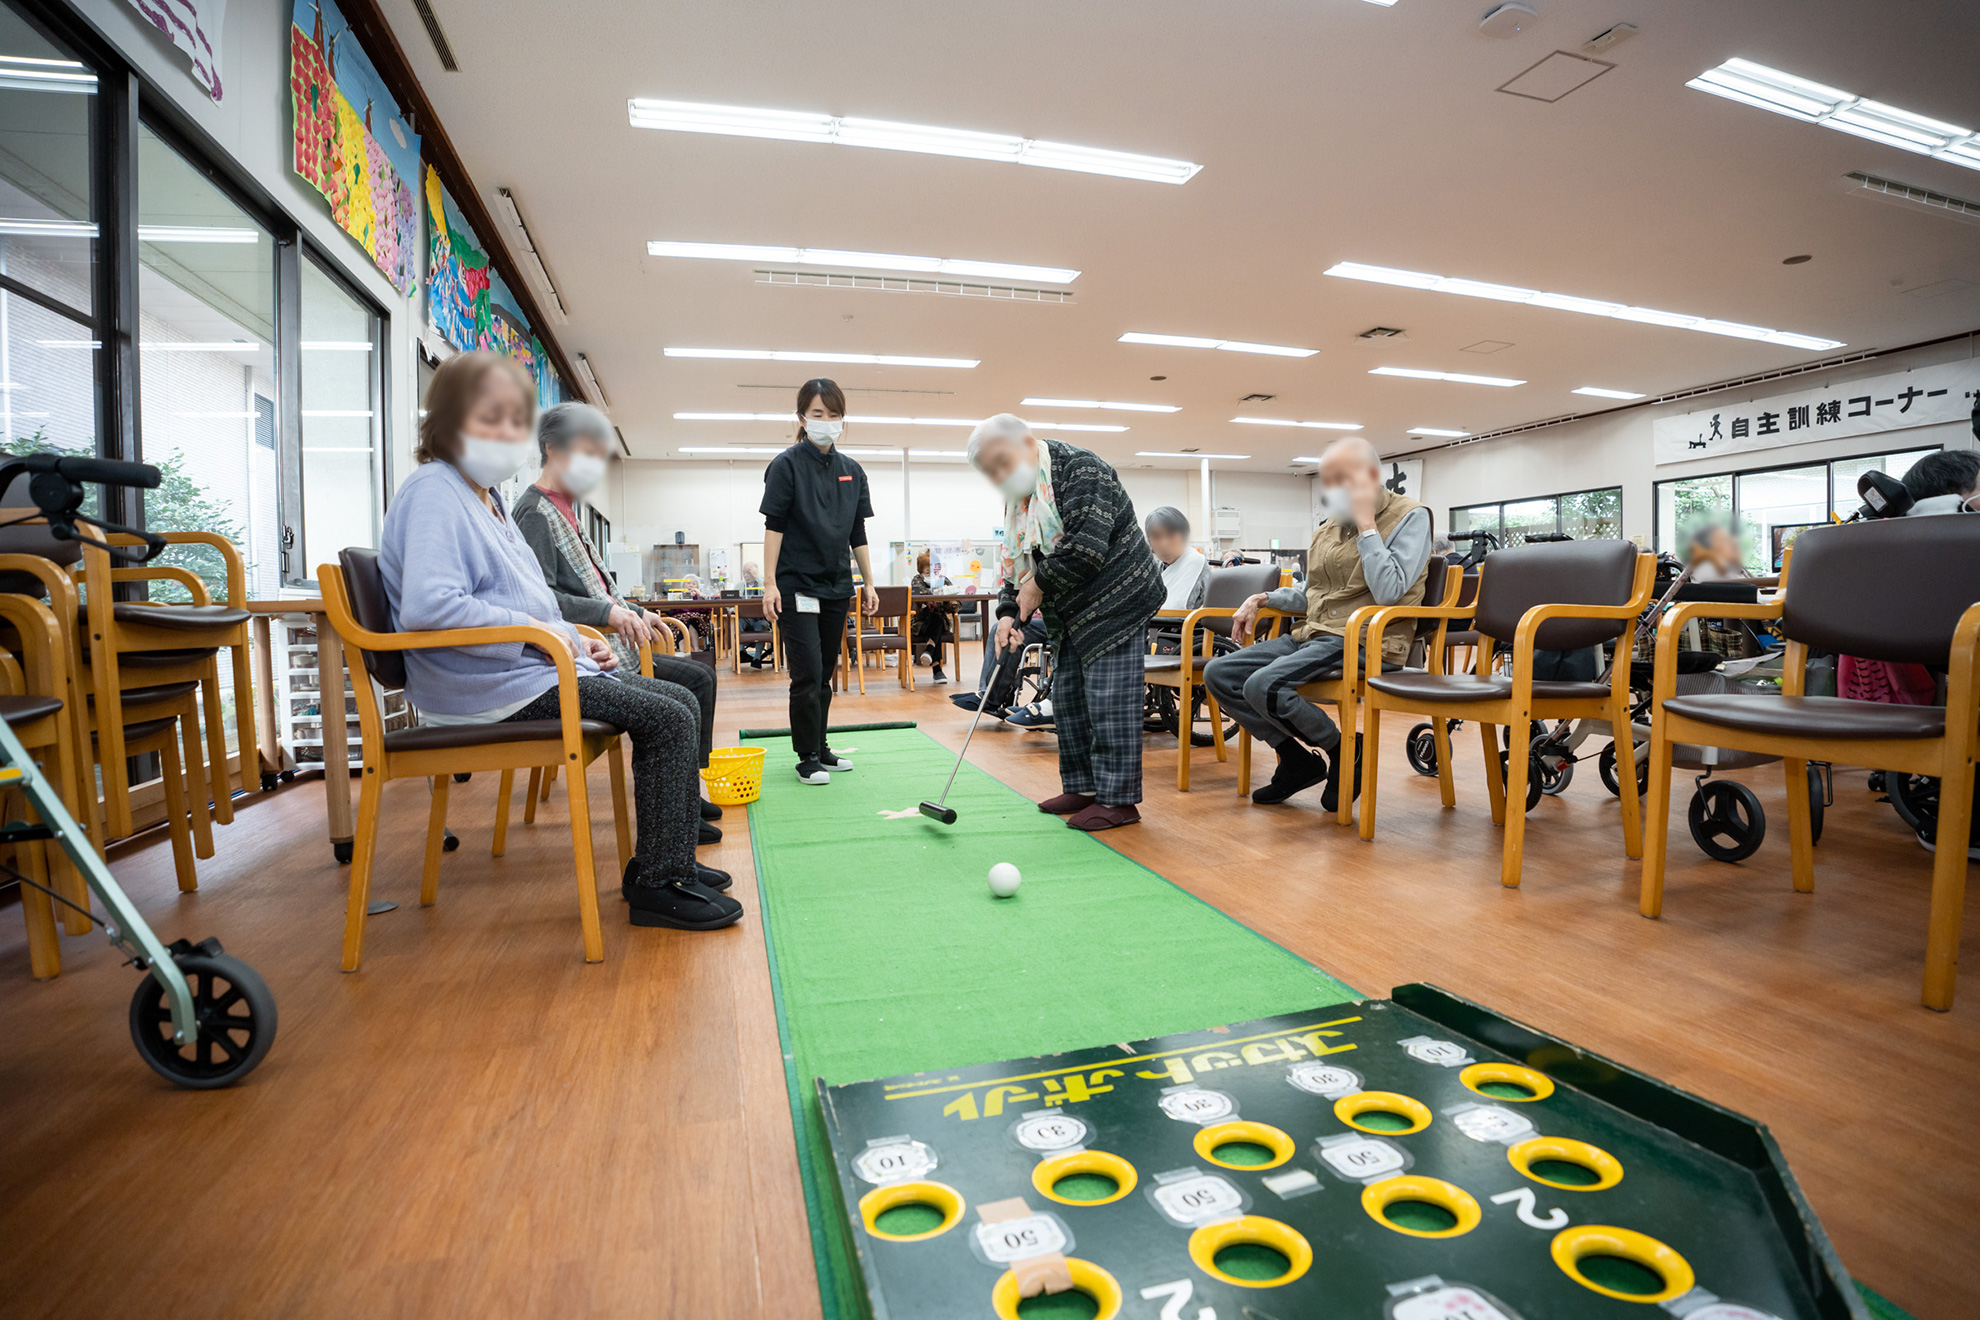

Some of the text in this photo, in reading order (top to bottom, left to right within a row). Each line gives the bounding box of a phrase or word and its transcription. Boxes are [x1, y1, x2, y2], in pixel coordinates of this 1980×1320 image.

[1731, 383, 1948, 439] 自主訓練コーナー
[1425, 1046, 1451, 1058] 10
[943, 1030, 1358, 1121] スカットボール
[1312, 1073, 1339, 1086] 30
[1037, 1125, 1065, 1139] 30
[880, 1155, 905, 1170] 10
[1347, 1150, 1381, 1167] 50
[1182, 1188, 1216, 1209] 50
[1490, 1186, 1569, 1230] 2
[1004, 1228, 1039, 1249] 50
